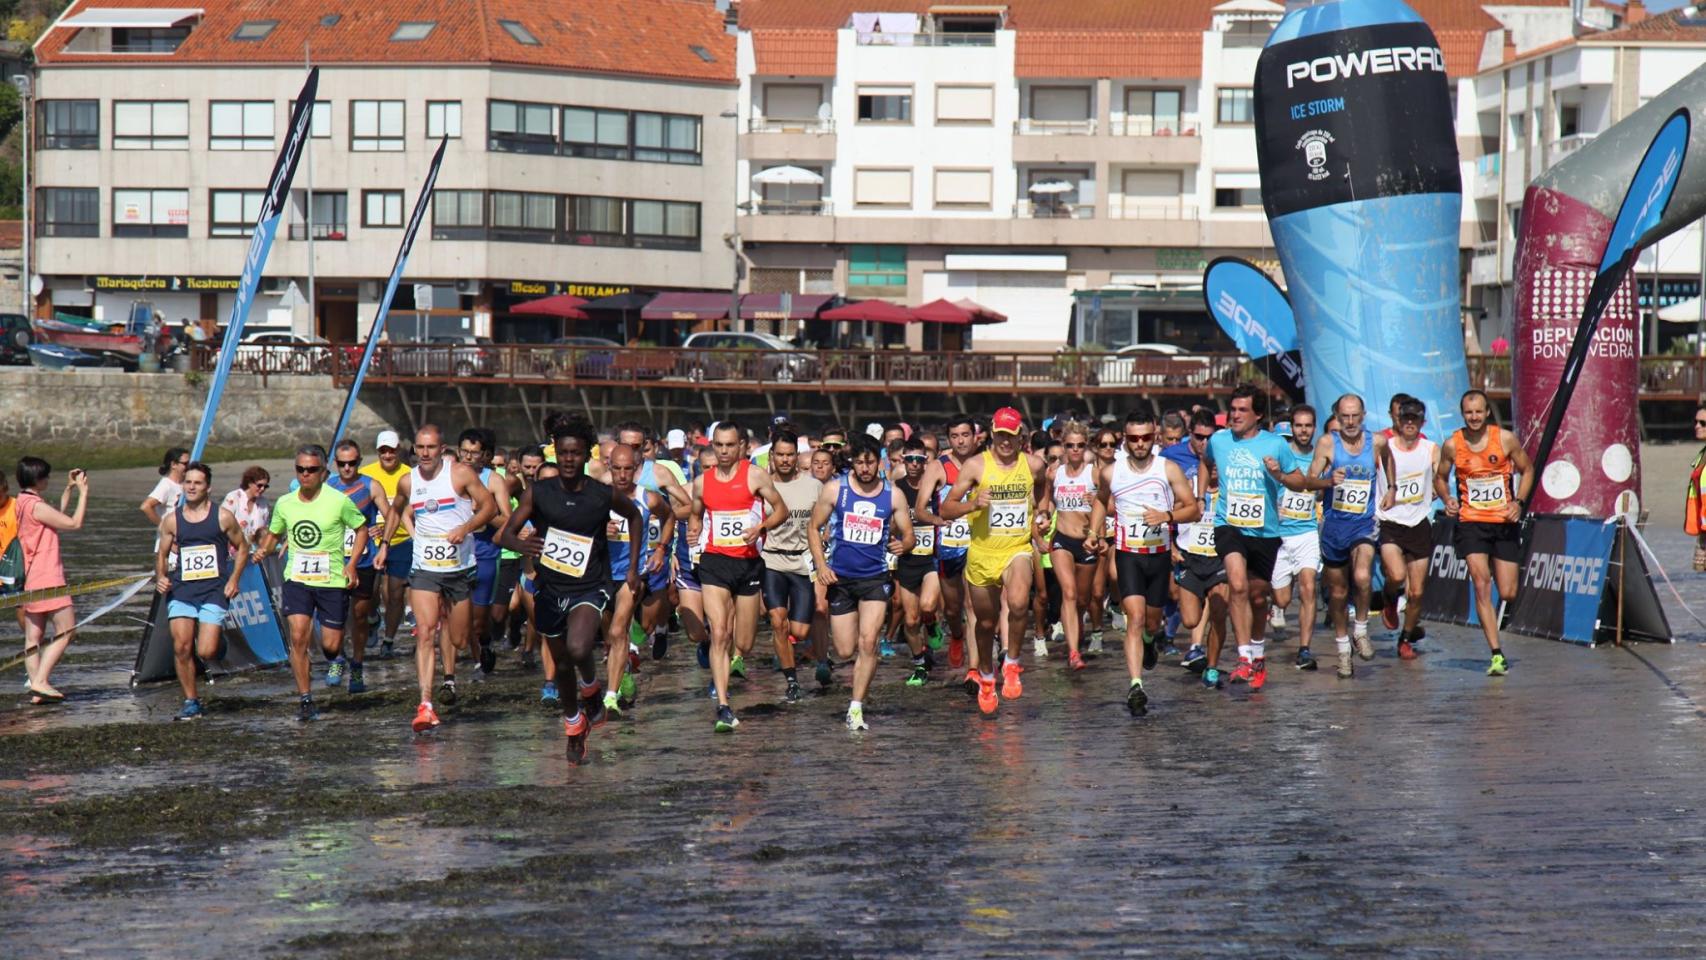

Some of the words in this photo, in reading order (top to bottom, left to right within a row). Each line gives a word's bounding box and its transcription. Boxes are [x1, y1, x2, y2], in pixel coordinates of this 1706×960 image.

[1291, 103, 1307, 120] ICE
[1308, 97, 1345, 116] STORM
[1533, 323, 1633, 344] DEPUACIÓN
[1533, 343, 1634, 360] PONVEDRA
[1335, 488, 1368, 504] 162
[1471, 487, 1502, 502] 210
[1229, 502, 1262, 518] 188
[1285, 497, 1312, 512] 191
[990, 511, 1025, 528] 234
[720, 521, 743, 537] 58
[850, 528, 874, 543] 1211
[1128, 523, 1162, 539] 174
[423, 544, 458, 560] 582
[544, 542, 585, 567] 229
[184, 554, 215, 571] 182
[300, 560, 321, 574] 11
[1524, 552, 1603, 596] POWERADE
